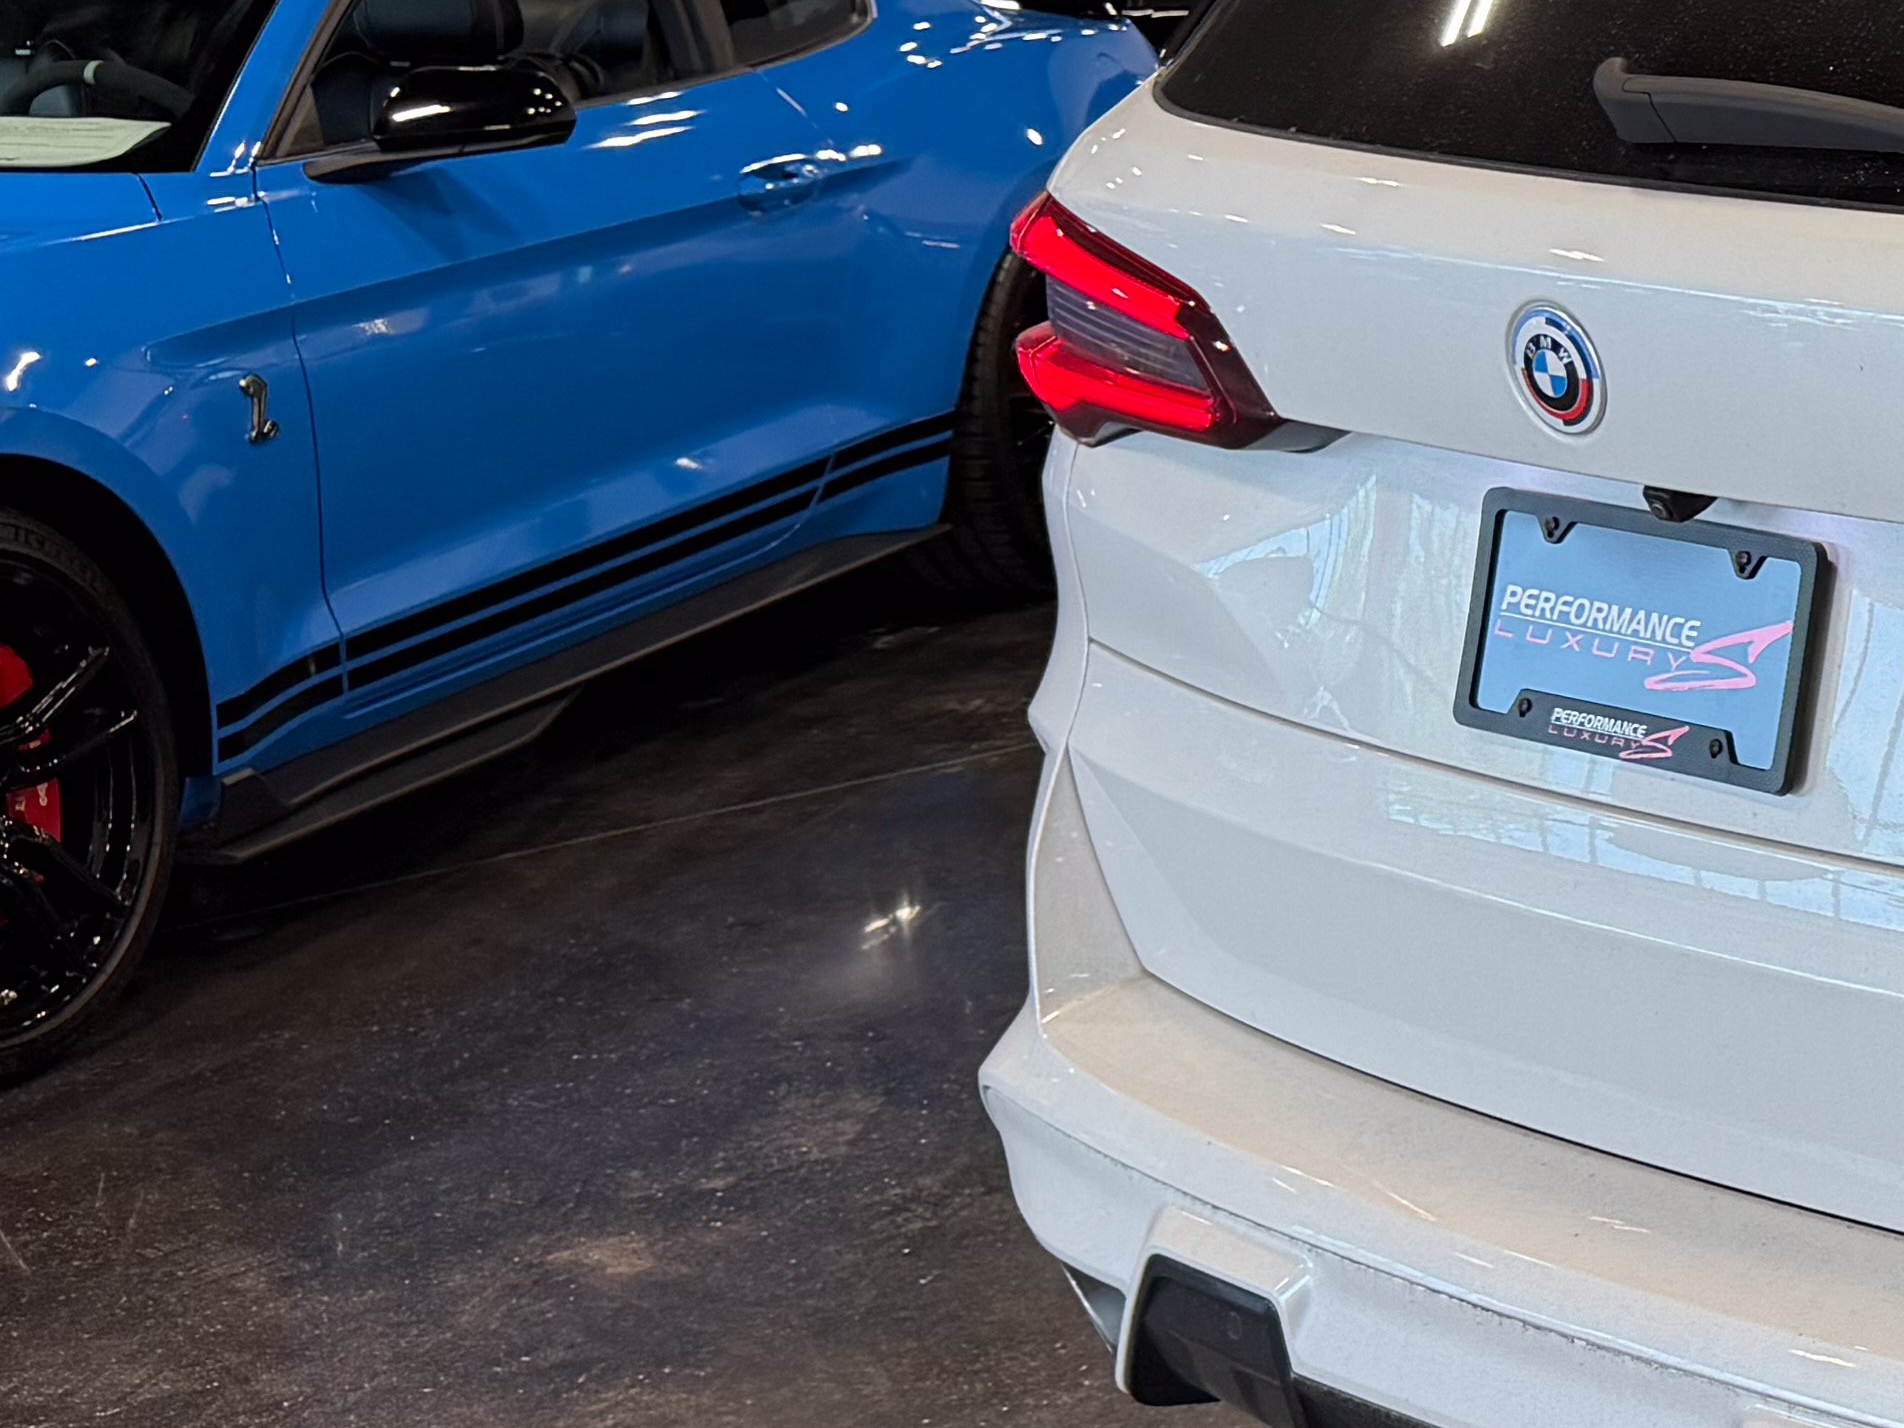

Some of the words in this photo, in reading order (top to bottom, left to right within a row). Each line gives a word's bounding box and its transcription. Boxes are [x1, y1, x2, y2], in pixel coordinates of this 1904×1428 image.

[1526, 335, 1573, 365] BMW
[1500, 583, 1702, 648] PERFORMANCE
[1493, 619, 1690, 672] LUXURY
[1547, 726, 1641, 750] LUXURY
[1550, 707, 1648, 739] PERFORMANCE
